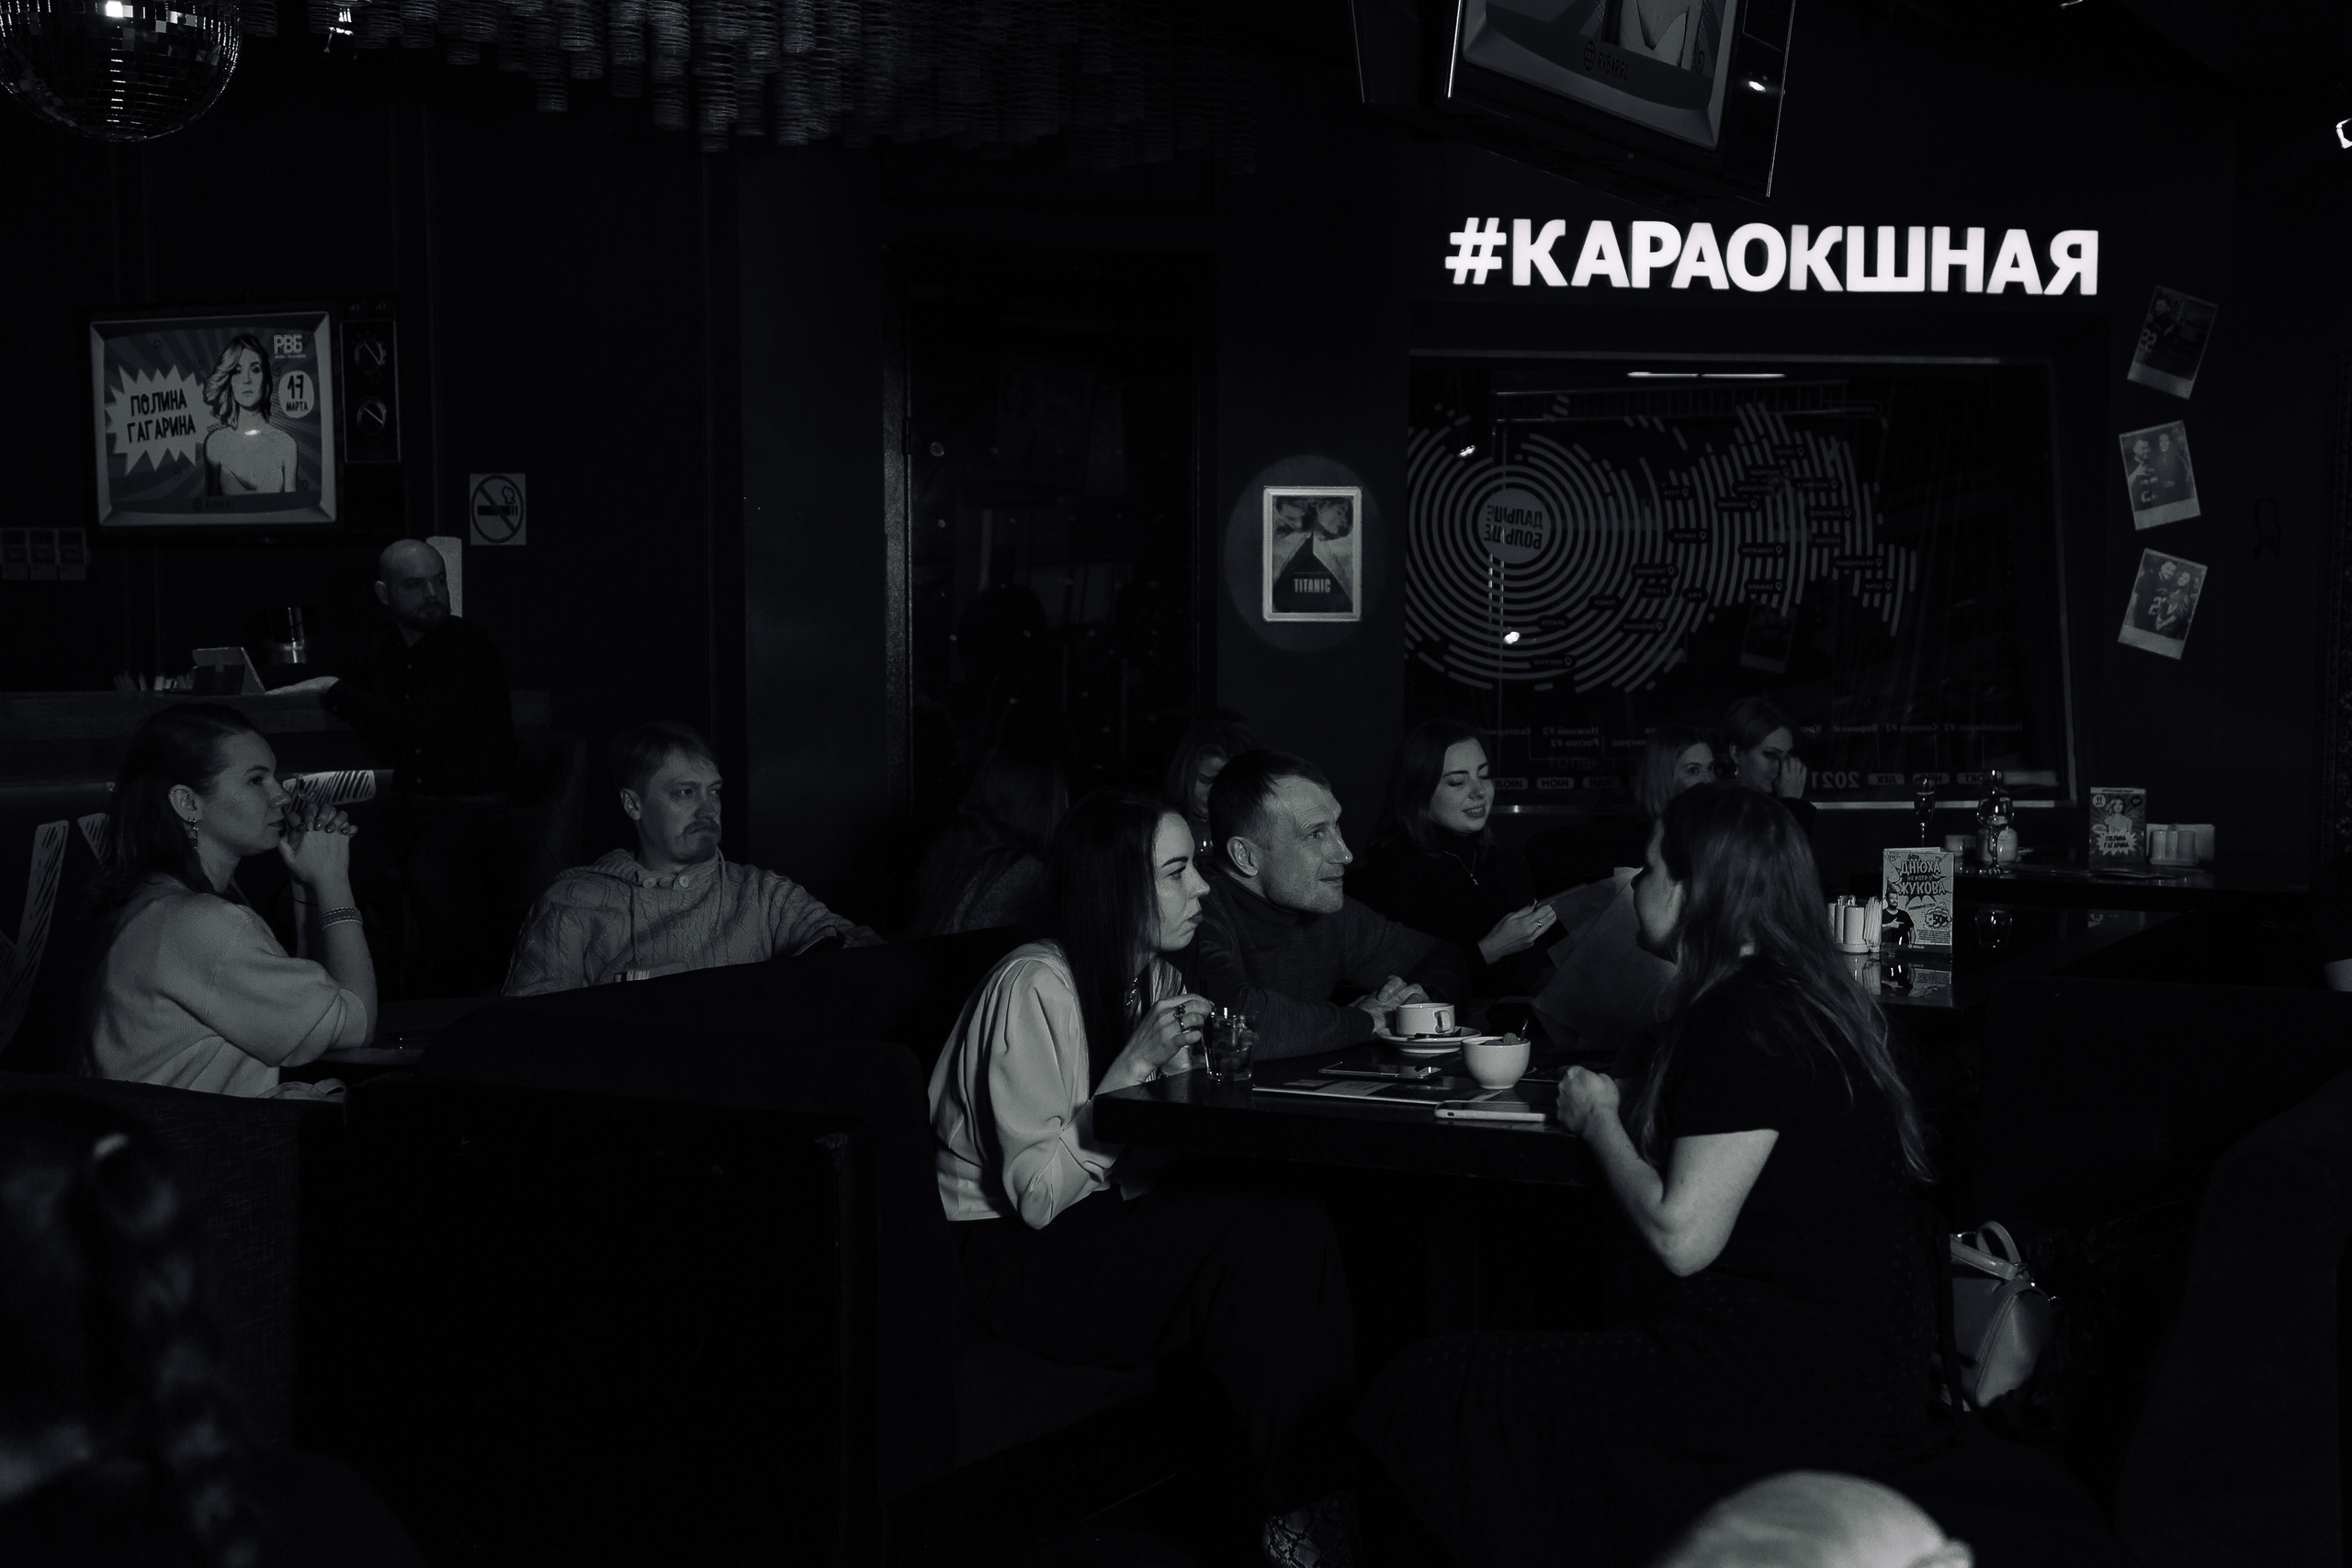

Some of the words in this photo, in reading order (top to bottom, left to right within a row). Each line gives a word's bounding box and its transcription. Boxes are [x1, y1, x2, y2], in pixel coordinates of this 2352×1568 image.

[1444, 217, 2099, 296] #КАРАОКШНАЯ
[272, 333, 303, 355] РВБ
[287, 374, 304, 400] 17
[130, 388, 187, 417] ПОЛИНА
[285, 400, 310, 412] МАРТА
[127, 413, 197, 444] ГАГАРИНА
[1294, 578, 1331, 593] TITANIC
[1899, 860, 1941, 876] ДНЮХА
[1898, 881, 1946, 896] ЖУКОВА
